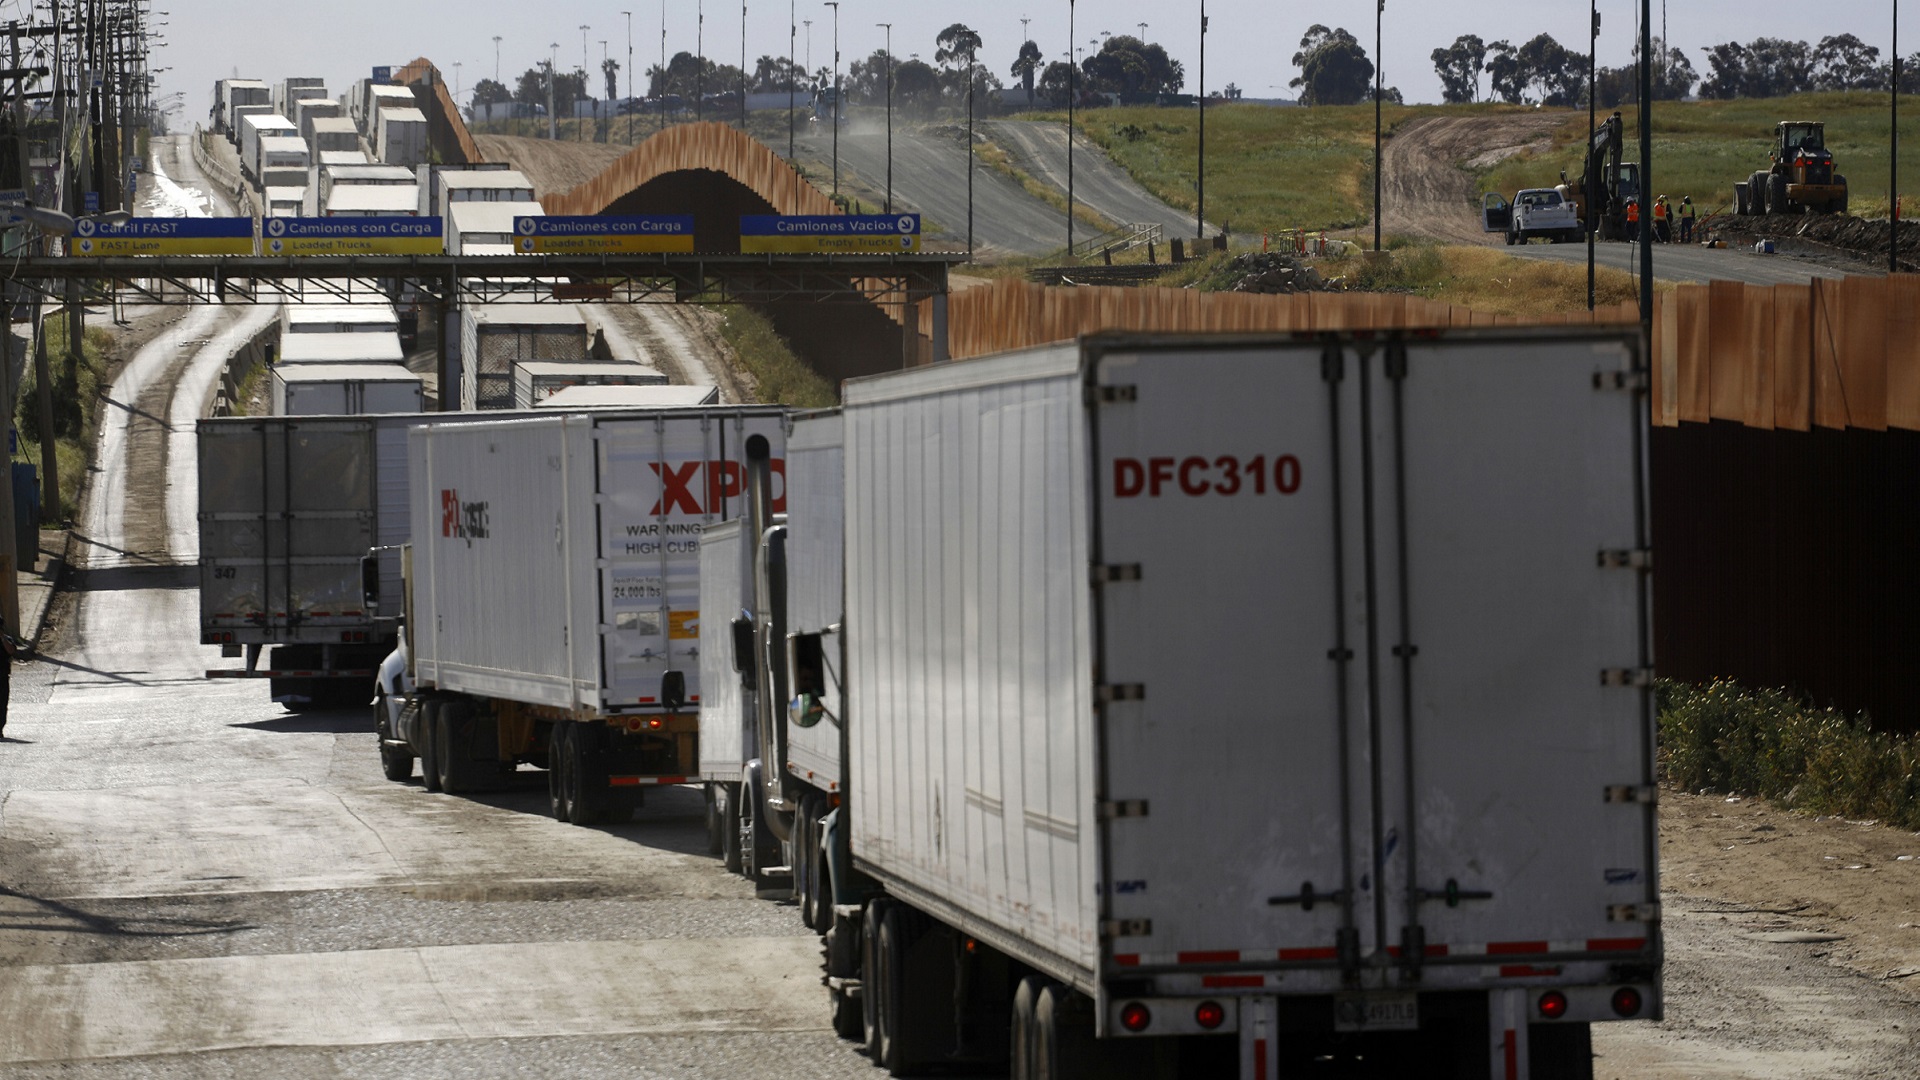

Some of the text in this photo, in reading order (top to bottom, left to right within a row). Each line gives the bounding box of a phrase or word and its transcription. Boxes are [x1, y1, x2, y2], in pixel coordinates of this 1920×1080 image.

[100, 222, 179, 234] Carril FAST
[289, 221, 432, 236] Camiones con Carga
[540, 219, 682, 234] Camiones con Carga
[777, 220, 894, 232] Camiones Vacios
[101, 239, 160, 250] FAST Lane
[294, 240, 372, 250] Loaded Trucks
[544, 238, 622, 248] Loaded Trucks
[818, 237, 894, 249] Empty Trucks
[1113, 454, 1302, 497] DFC310
[626, 542, 661, 555] HIGH
[215, 568, 236, 578] 347
[613, 586, 661, 598] 24,000 lbs
